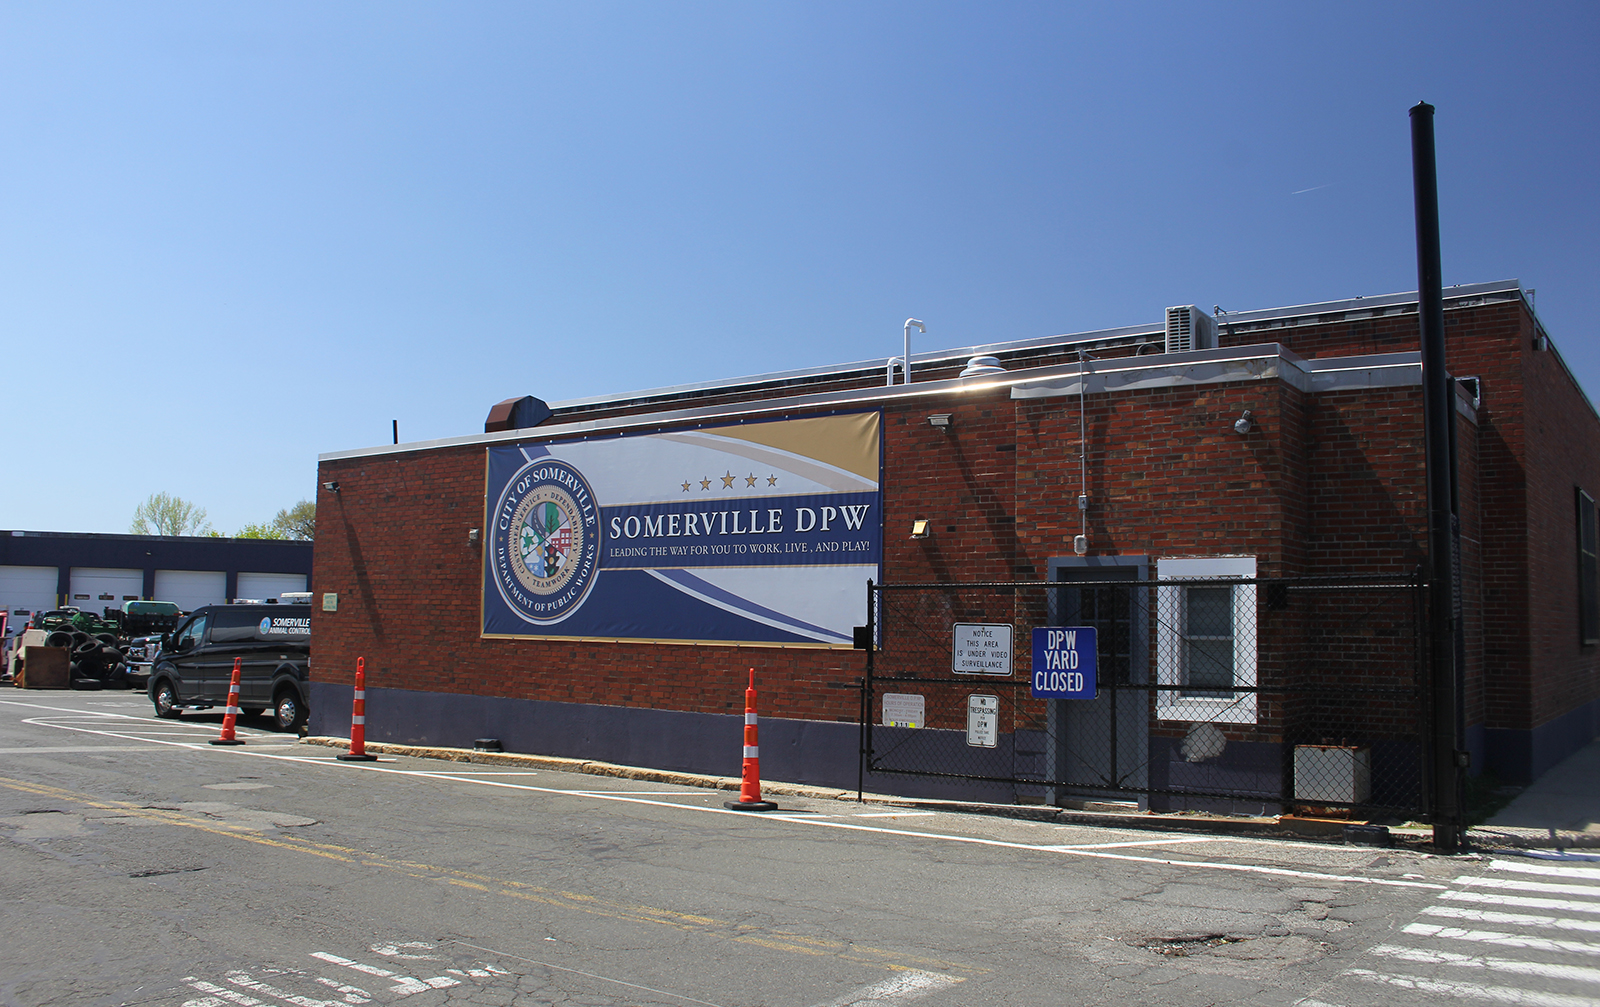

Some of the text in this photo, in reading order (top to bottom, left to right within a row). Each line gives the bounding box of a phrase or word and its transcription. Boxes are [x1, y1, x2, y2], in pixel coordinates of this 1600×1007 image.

[500, 467, 595, 531] CITY OF SOMERVILLE
[550, 492, 579, 554] DEPENDABILITY
[610, 505, 870, 539] SOMERVILLE DPW
[513, 493, 541, 574] CUSTOMER SERVICE
[610, 547, 647, 557] LEADING
[649, 546, 668, 556] THE
[670, 546, 688, 555] WAY
[690, 546, 708, 555] FOR
[711, 545, 730, 554] YOU
[733, 544, 747, 554] TO
[749, 543, 782, 554] WORK,
[815, 542, 839, 552] AND
[842, 541, 870, 551] PLAY!
[498, 544, 595, 612] DEPARTMENT OF PUBLIC WORKS
[532, 567, 570, 588] TEAMWORK
[272, 618, 310, 626] SOMERVILLE
[1048, 631, 1076, 649] DPW
[962, 660, 1002, 668] SURVEILLANCE
[1044, 650, 1078, 669] YARD
[1035, 671, 1083, 692] CLOSED
[970, 706, 996, 714] TRESPASSING
